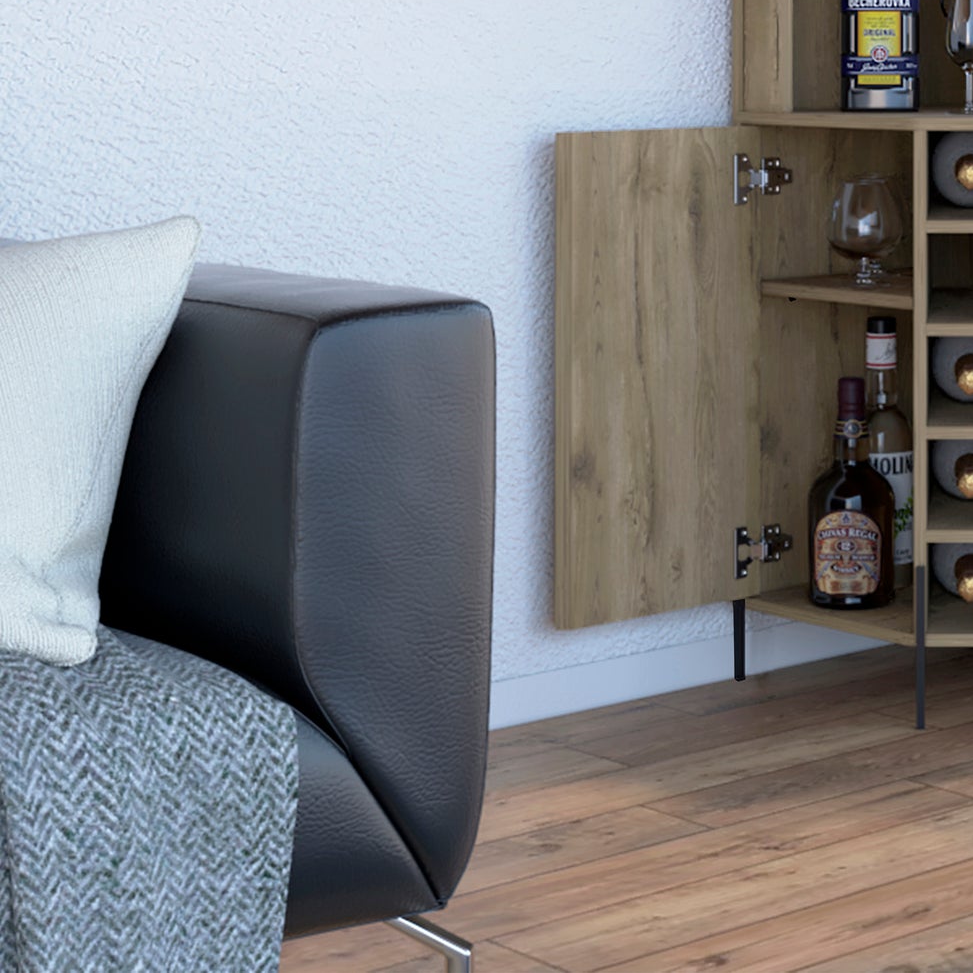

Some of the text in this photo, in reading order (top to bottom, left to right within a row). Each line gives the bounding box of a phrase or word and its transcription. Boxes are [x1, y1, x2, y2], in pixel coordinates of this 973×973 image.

[863, 28, 896, 37] ORIGINAL
[818, 527, 877, 541] CHIVAS REGAL
